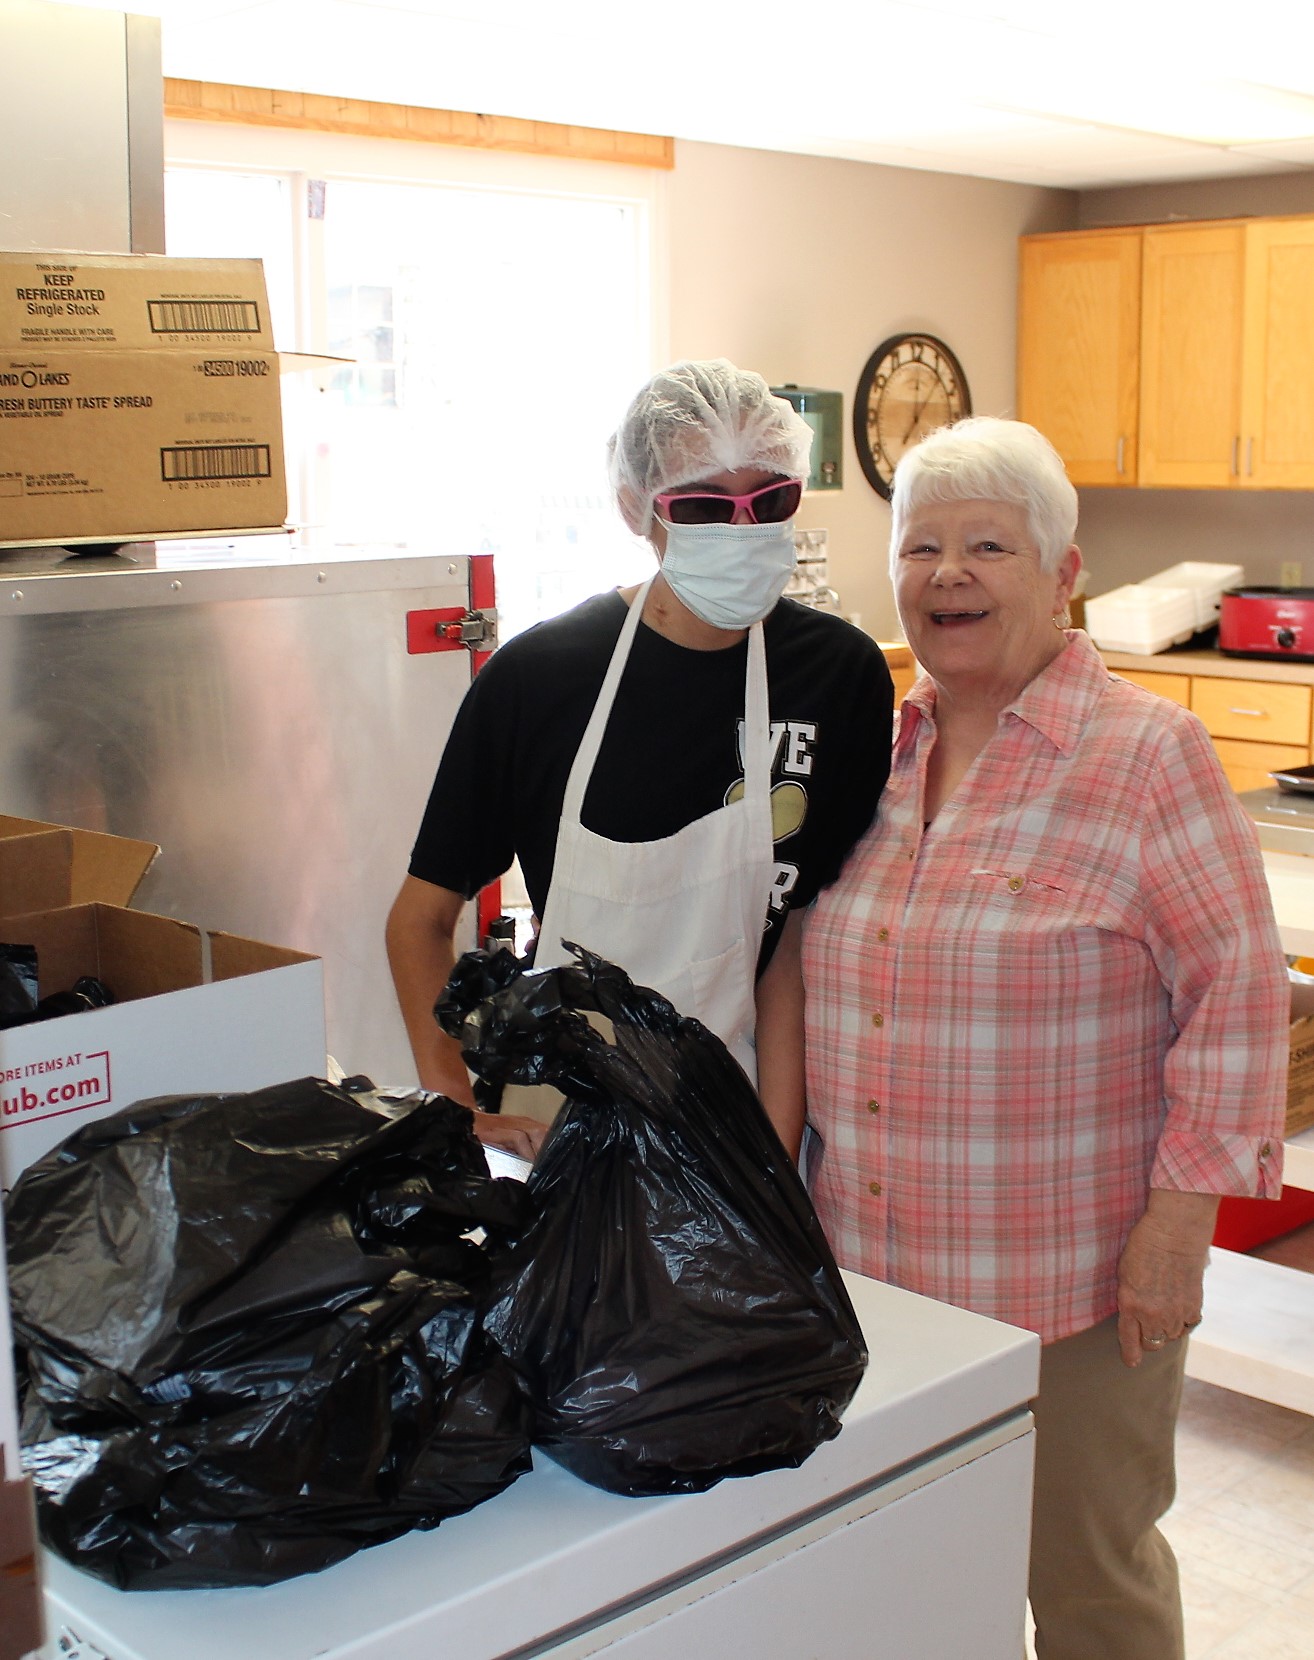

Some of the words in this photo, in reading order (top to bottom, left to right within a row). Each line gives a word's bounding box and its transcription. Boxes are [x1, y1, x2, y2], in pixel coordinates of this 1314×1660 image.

[44, 274, 74, 286] KEEP
[16, 288, 106, 301] REFRIGERATED
[27, 302, 64, 317] Single
[66, 303, 100, 315] Stock
[235, 360, 267, 377] 19002
[21, 370, 38, 389] O
[39, 372, 71, 386] LAKES
[28, 398, 73, 411] BUTTERY
[113, 396, 153, 409] SPREAD
[25, 1057, 63, 1077] ITEMS
[66, 1053, 81, 1067] AT
[3, 1077, 100, 1116] ub.com
